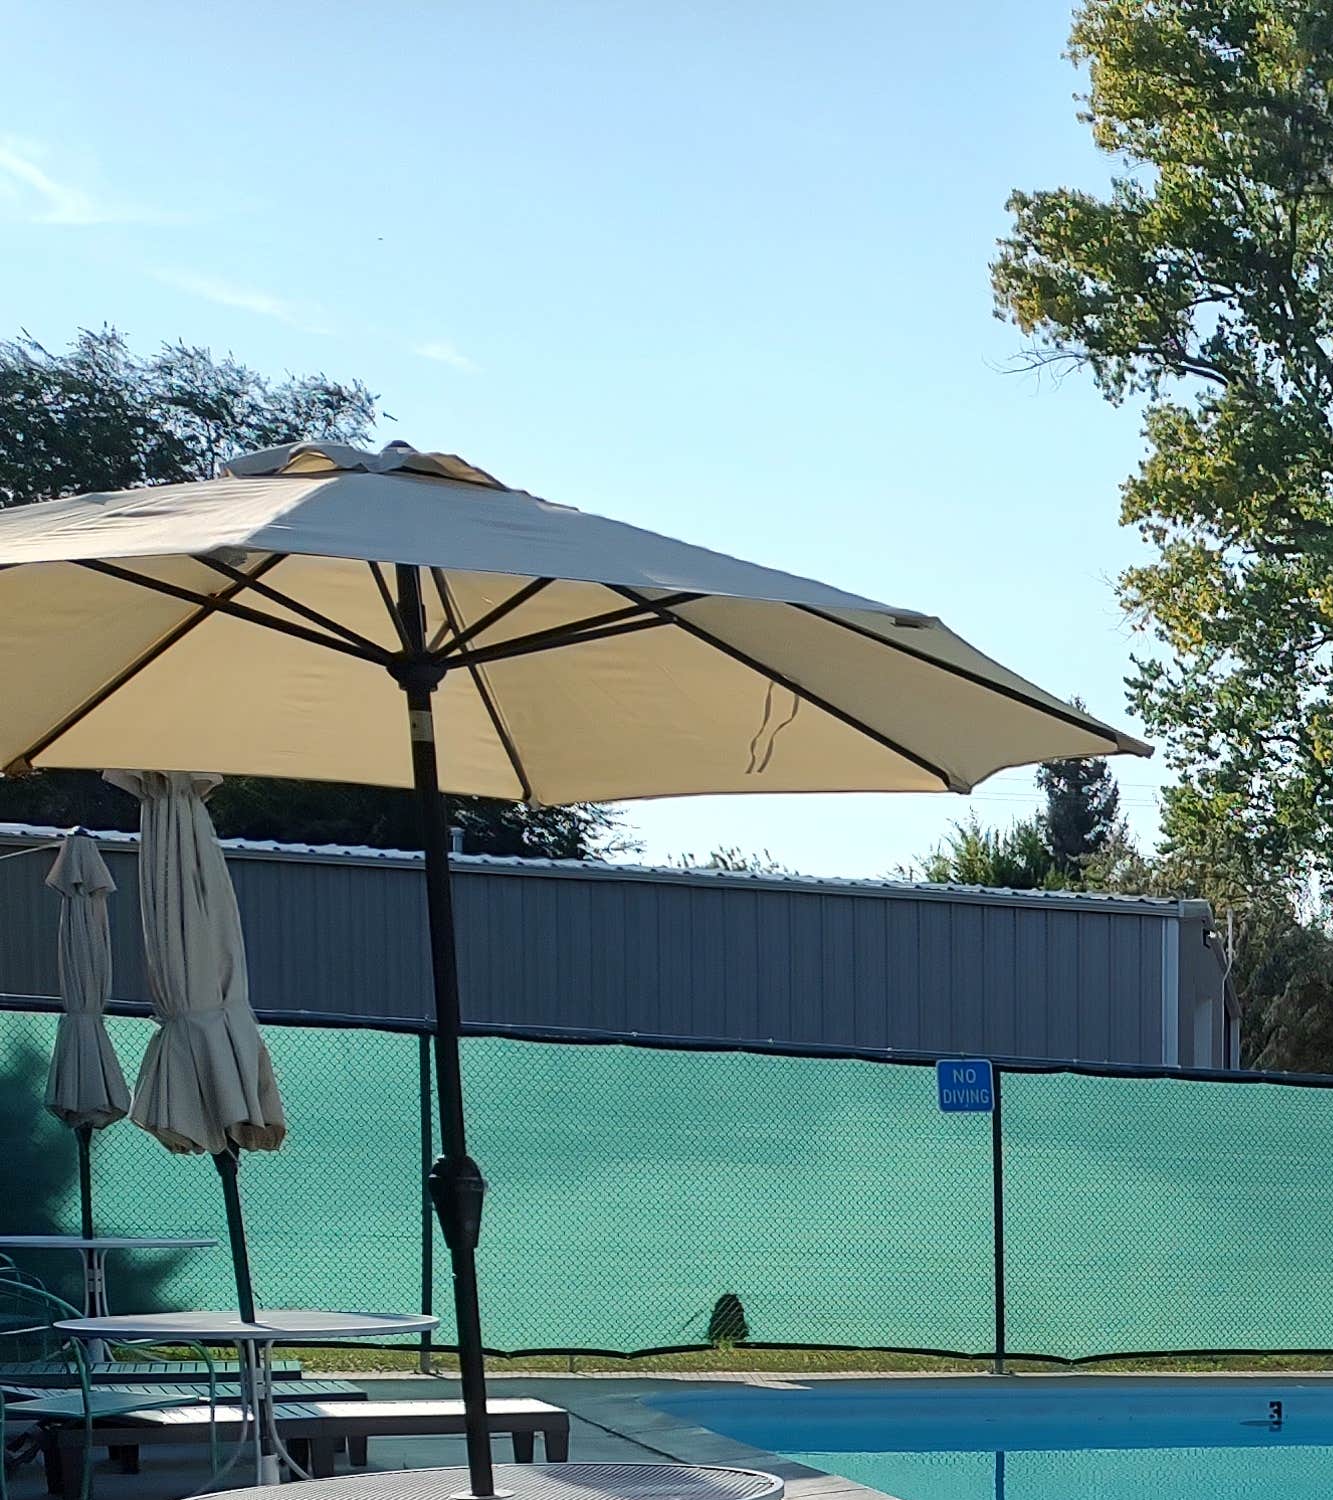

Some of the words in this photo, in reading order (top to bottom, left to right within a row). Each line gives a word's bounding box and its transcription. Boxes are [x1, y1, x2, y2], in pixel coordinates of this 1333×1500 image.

[953, 1068, 976, 1084] NO
[943, 1089, 990, 1104] DIVING
[1269, 1401, 1282, 1424] 3
